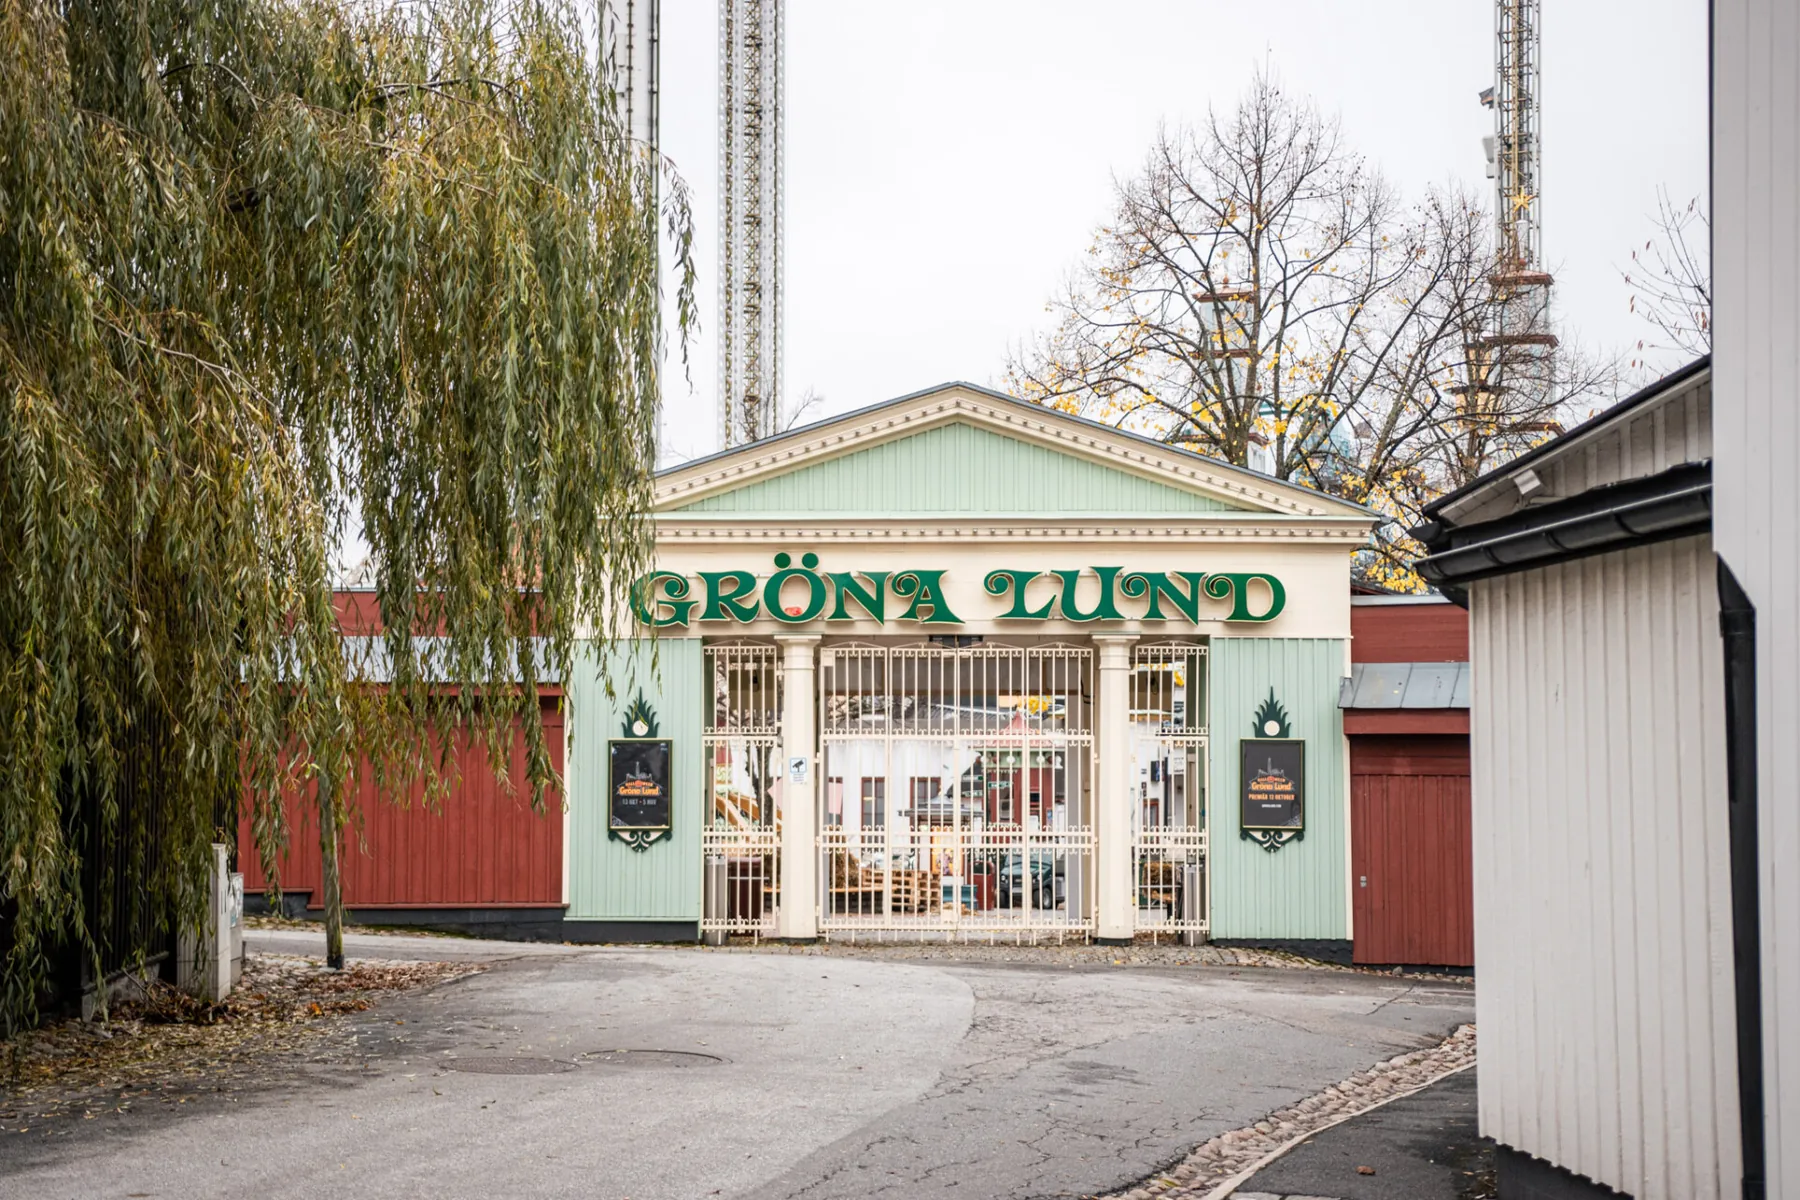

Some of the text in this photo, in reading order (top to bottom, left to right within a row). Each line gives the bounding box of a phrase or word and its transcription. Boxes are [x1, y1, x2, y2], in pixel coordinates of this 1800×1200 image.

[630, 552, 1287, 627] GRÖNA LUND
[642, 786, 659, 795] Lund
[1274, 782, 1292, 790] Lund
